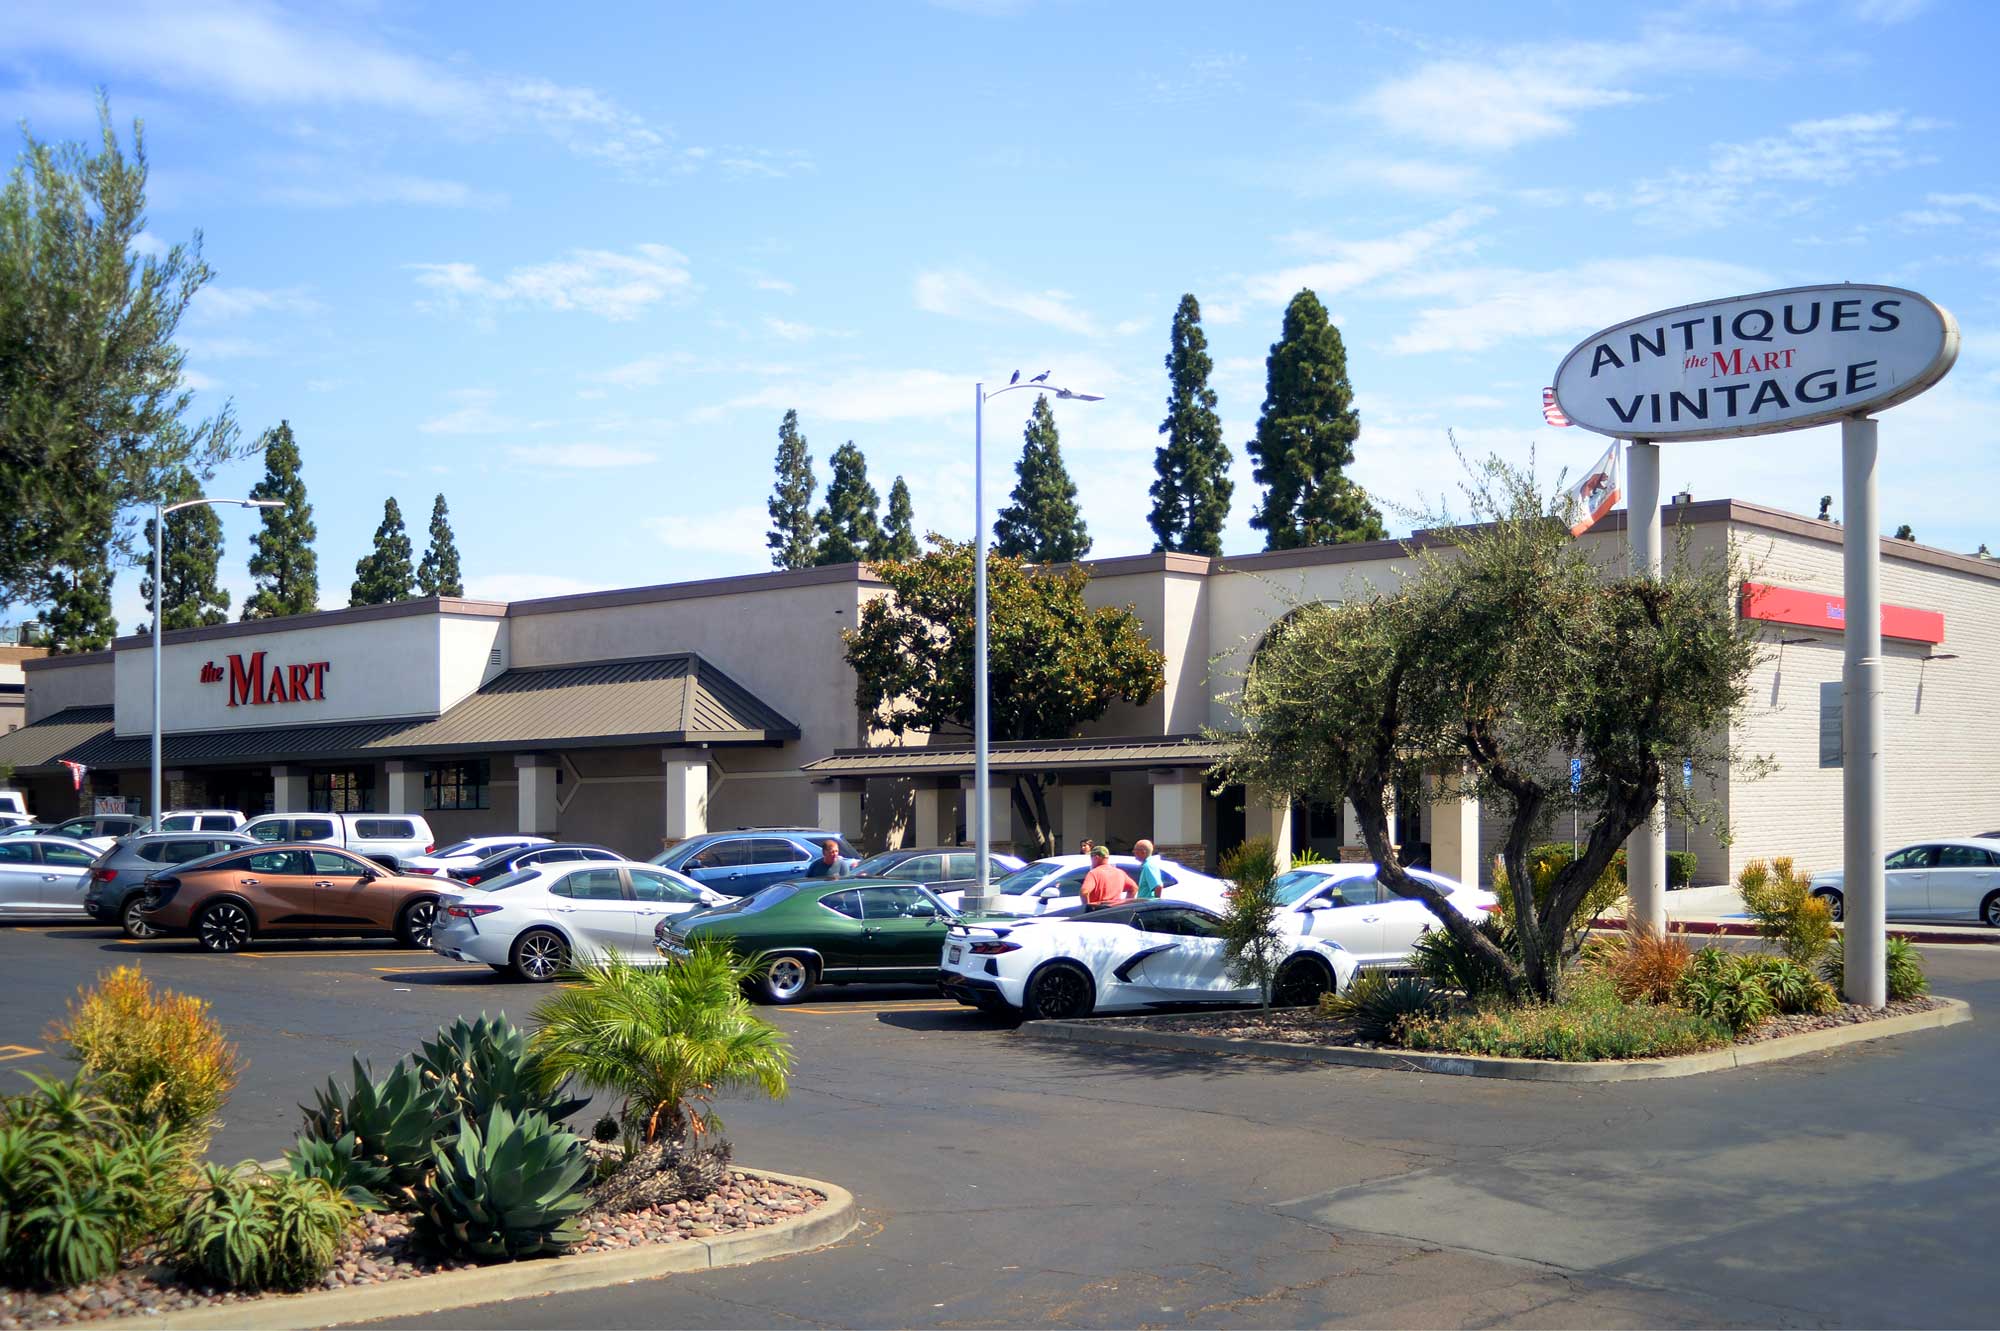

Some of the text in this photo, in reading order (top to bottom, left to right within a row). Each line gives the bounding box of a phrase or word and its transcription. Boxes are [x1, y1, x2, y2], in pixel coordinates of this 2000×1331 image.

[1590, 300, 1902, 378] ANTIQUES
[1685, 348, 1796, 378] the MART
[1606, 360, 1878, 423] VINTAGE
[200, 651, 330, 706] the MART
